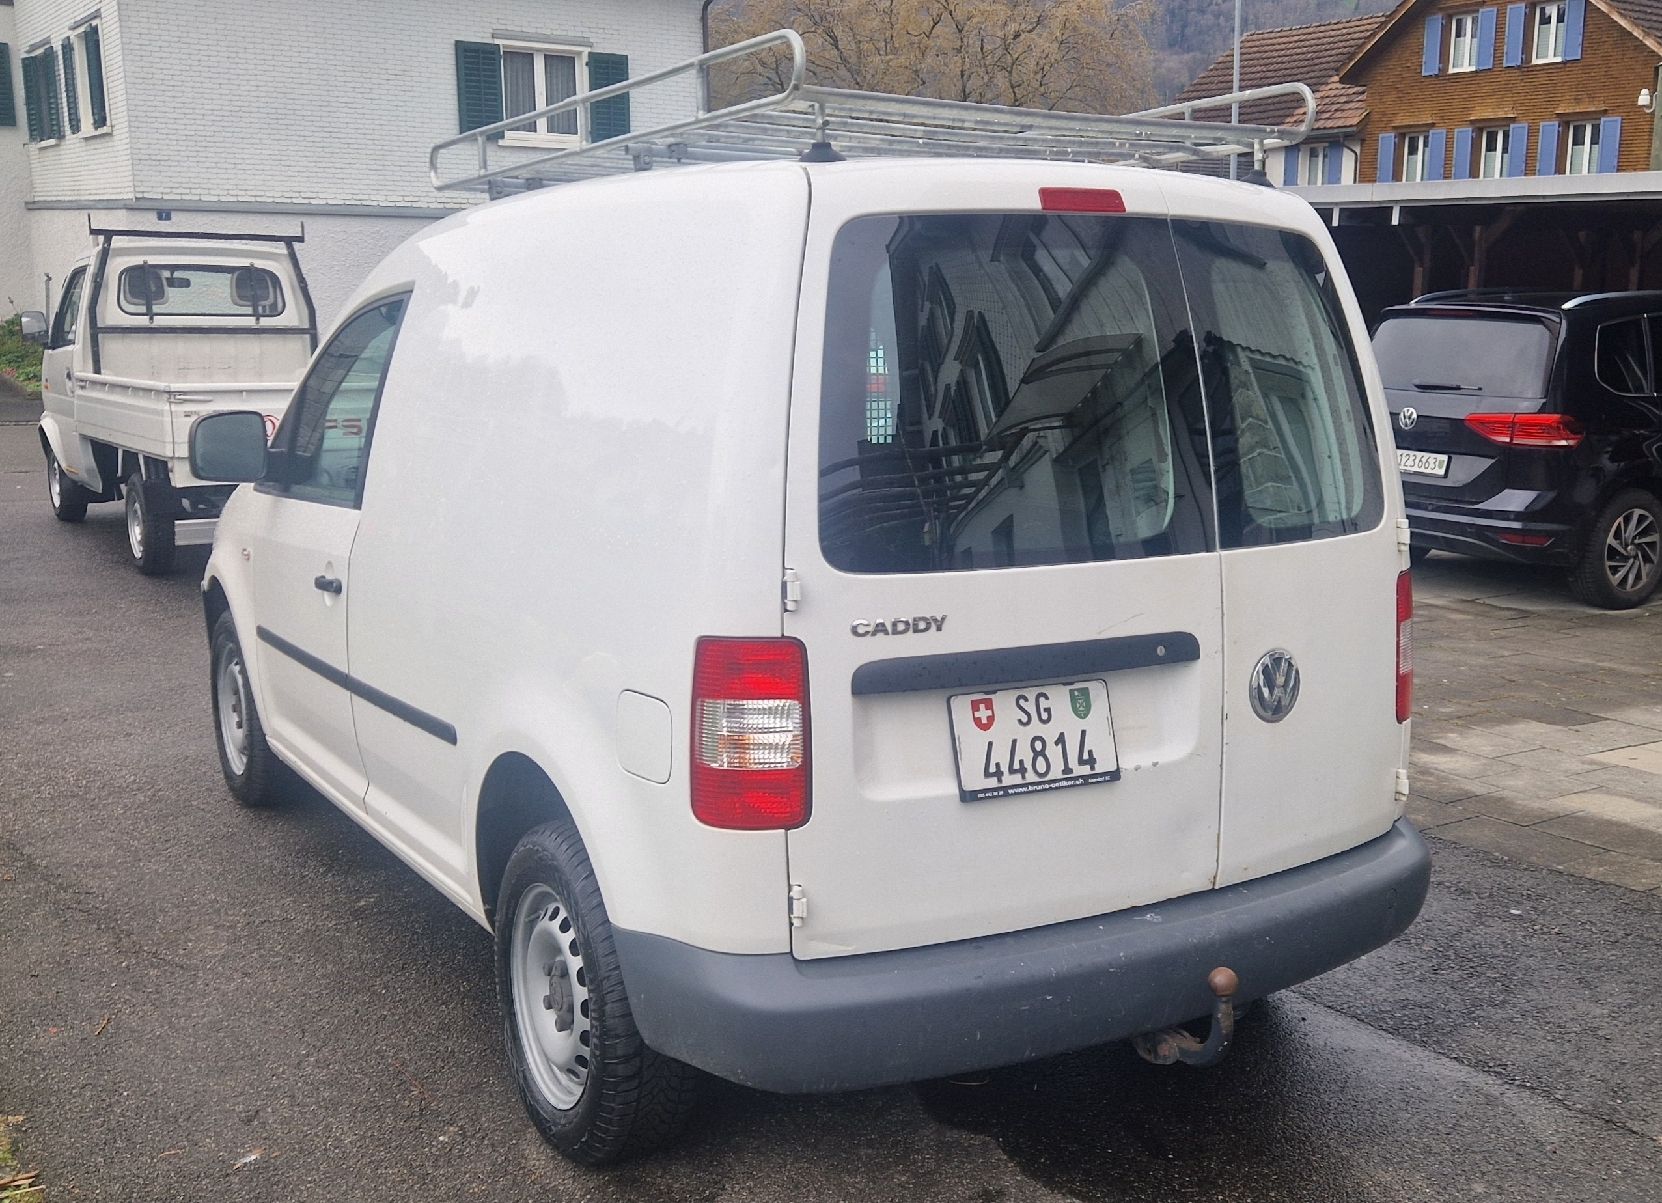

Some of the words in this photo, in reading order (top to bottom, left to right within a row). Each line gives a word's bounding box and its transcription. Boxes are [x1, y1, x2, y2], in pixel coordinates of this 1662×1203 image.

[850, 614, 948, 637] CADDY
[1015, 691, 1052, 727] SG
[983, 729, 1097, 784] 44814
